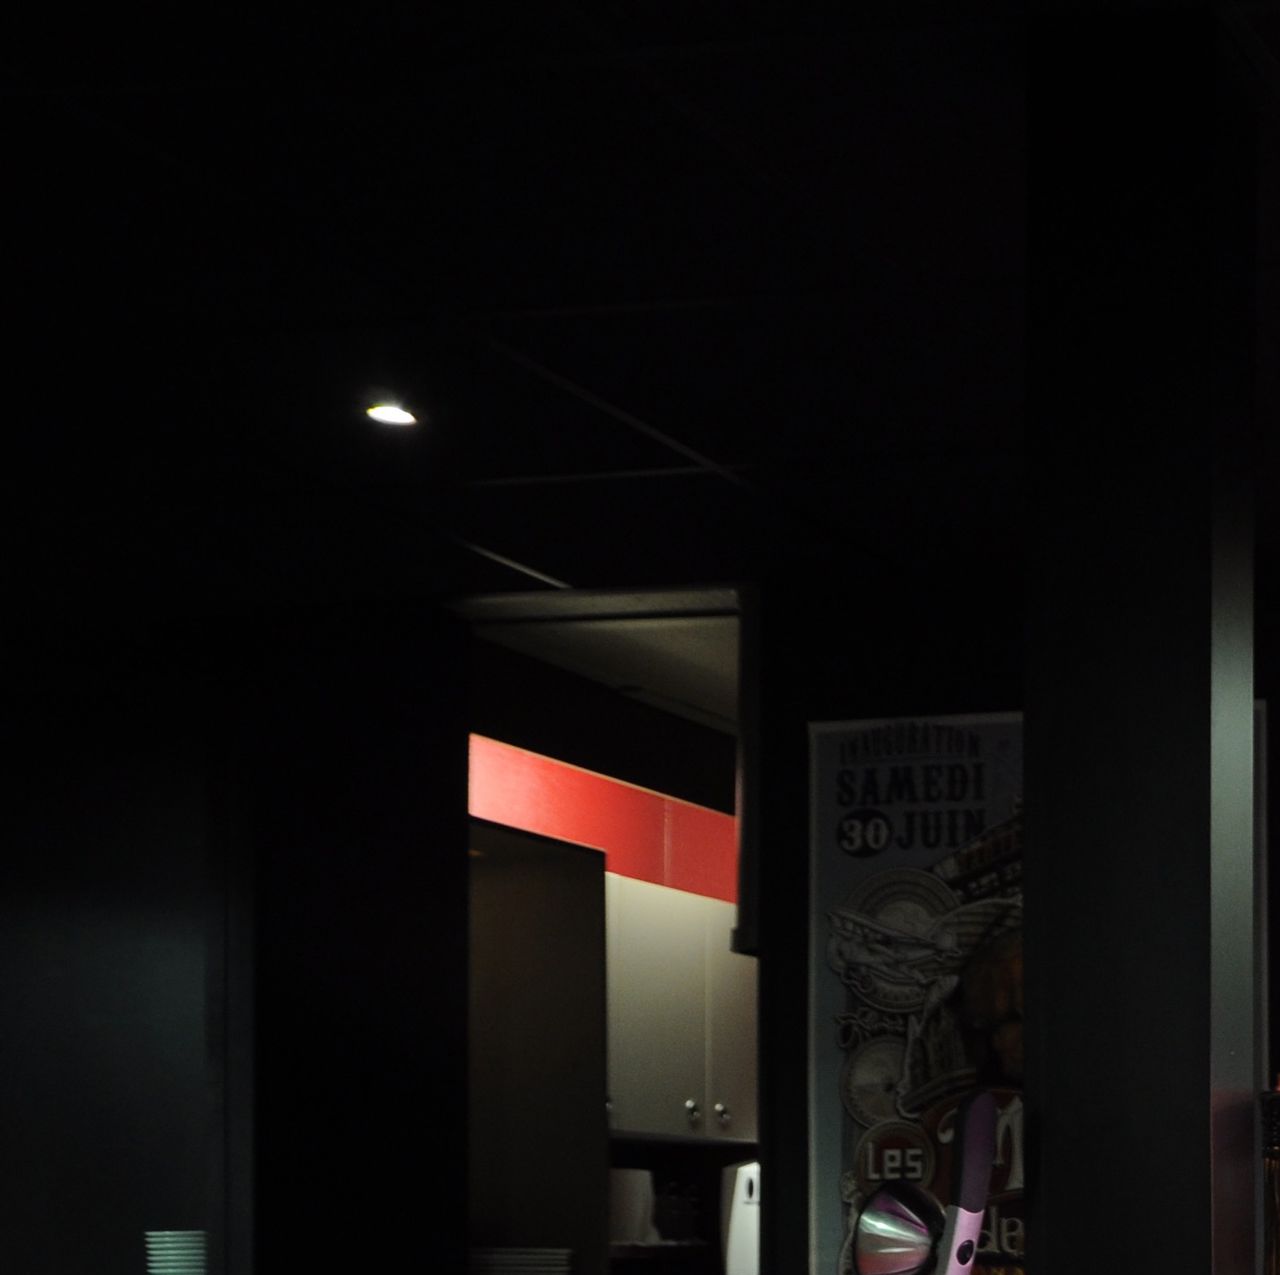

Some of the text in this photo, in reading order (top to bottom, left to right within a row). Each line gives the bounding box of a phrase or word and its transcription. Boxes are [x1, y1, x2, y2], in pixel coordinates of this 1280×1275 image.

[836, 762, 985, 807] SAMEDI
[839, 808, 986, 851] 30 JUIN
[867, 1140, 924, 1181] Les
